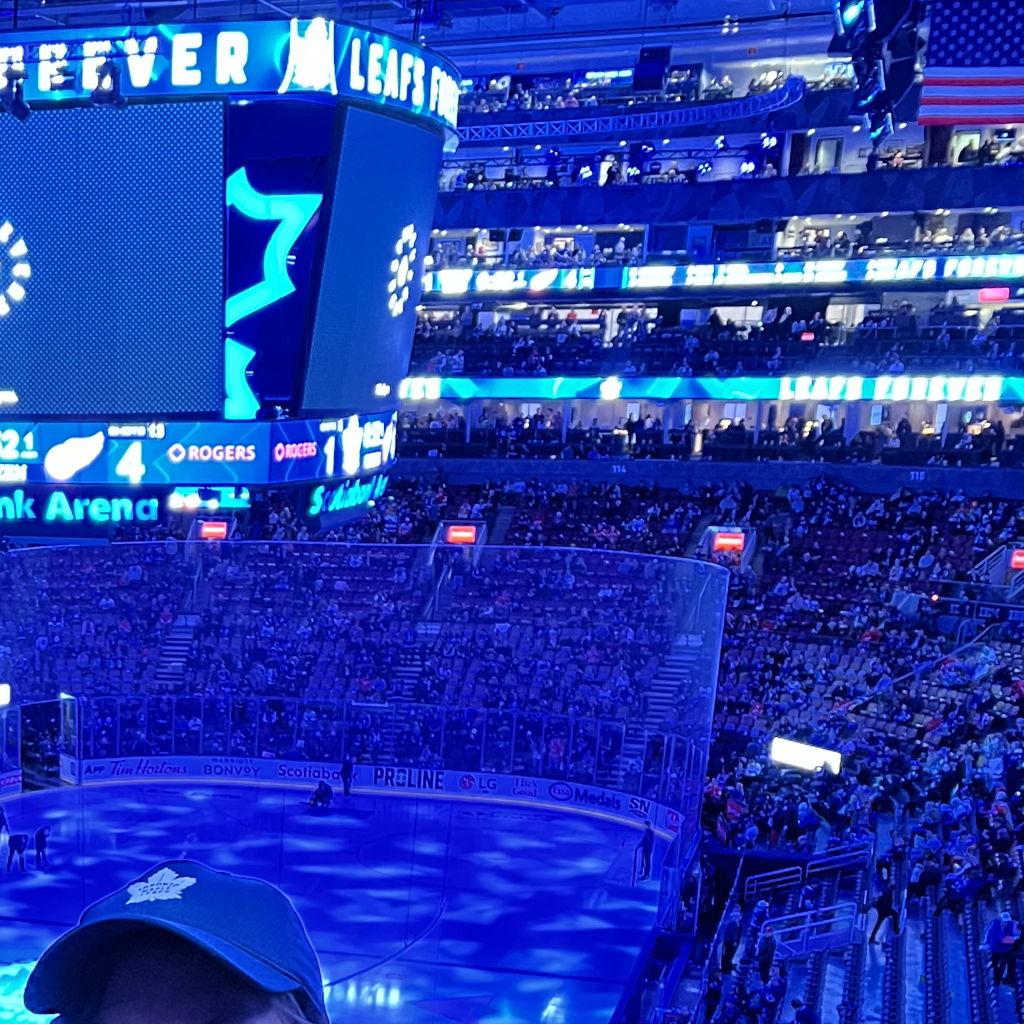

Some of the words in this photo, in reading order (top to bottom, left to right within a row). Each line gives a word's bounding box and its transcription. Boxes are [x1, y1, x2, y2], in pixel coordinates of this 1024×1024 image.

[350, 37, 425, 106] LEAFS
[187, 445, 256, 461] ROGERS
[285, 442, 317, 458] ROGERS
[115, 441, 145, 482] 4
[45, 490, 159, 522] Arena
[109, 759, 134, 776] Tim
[135, 758, 188, 776] Hortons
[203, 764, 262, 777] BONVOY
[277, 764, 359, 782] Scotiabak
[373, 766, 444, 791] PROLINE
[478, 777, 498, 792] LG
[574, 786, 622, 811] Medals
[628, 796, 651, 814] SN
